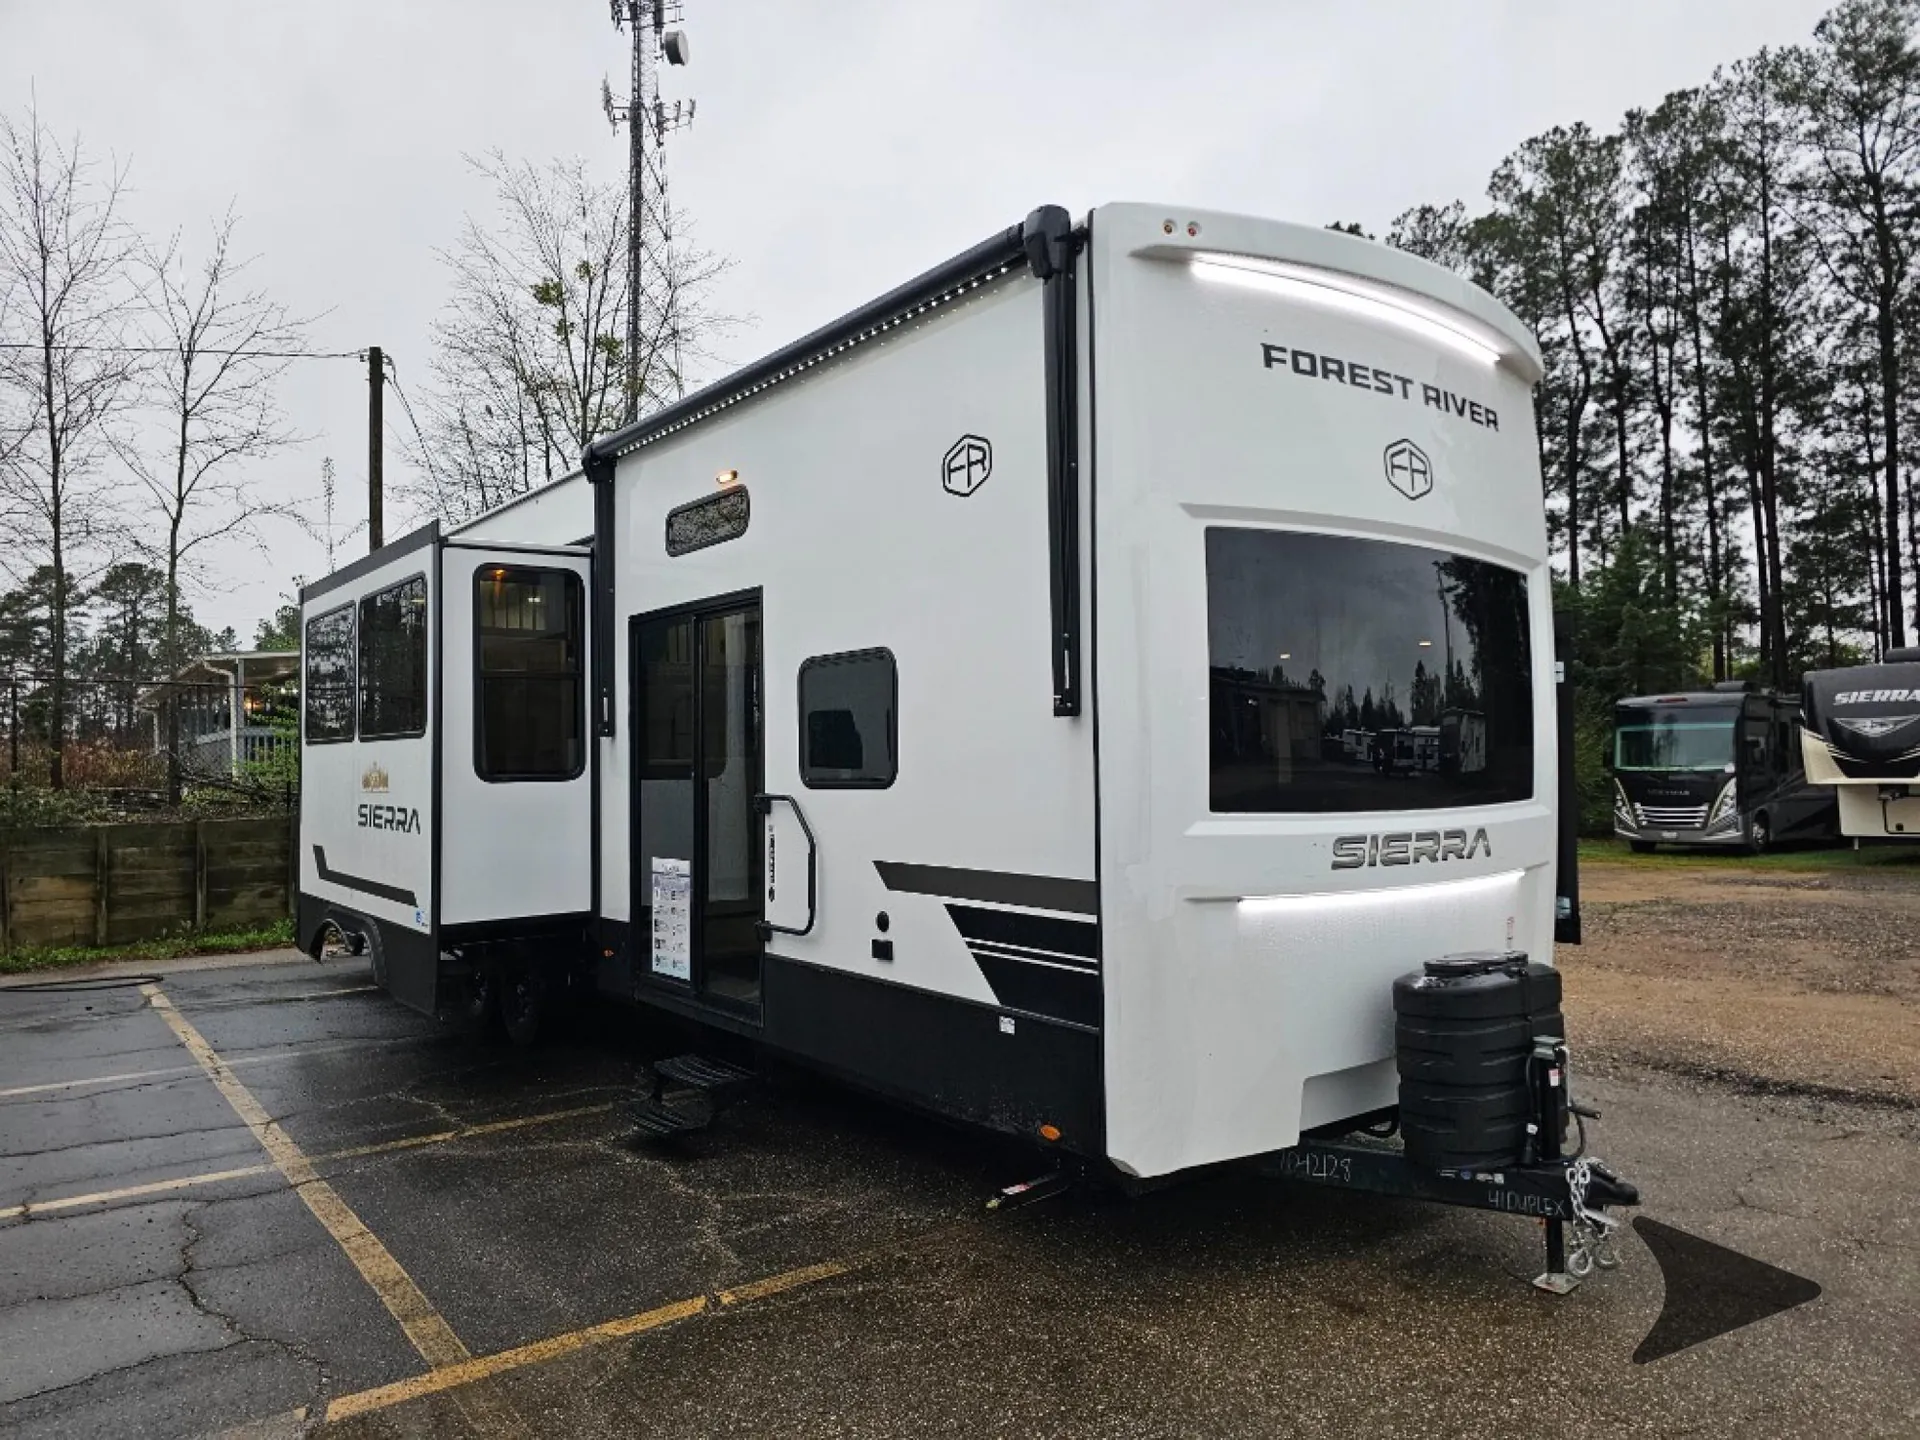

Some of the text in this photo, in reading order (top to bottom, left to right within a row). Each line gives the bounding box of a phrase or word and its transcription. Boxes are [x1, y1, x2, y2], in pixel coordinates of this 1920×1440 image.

[1260, 342, 1499, 432] FOREST RIVER
[1832, 689, 1920, 706] SIERRA
[357, 804, 421, 835] SIERRA
[1331, 828, 1491, 870] SIERRA
